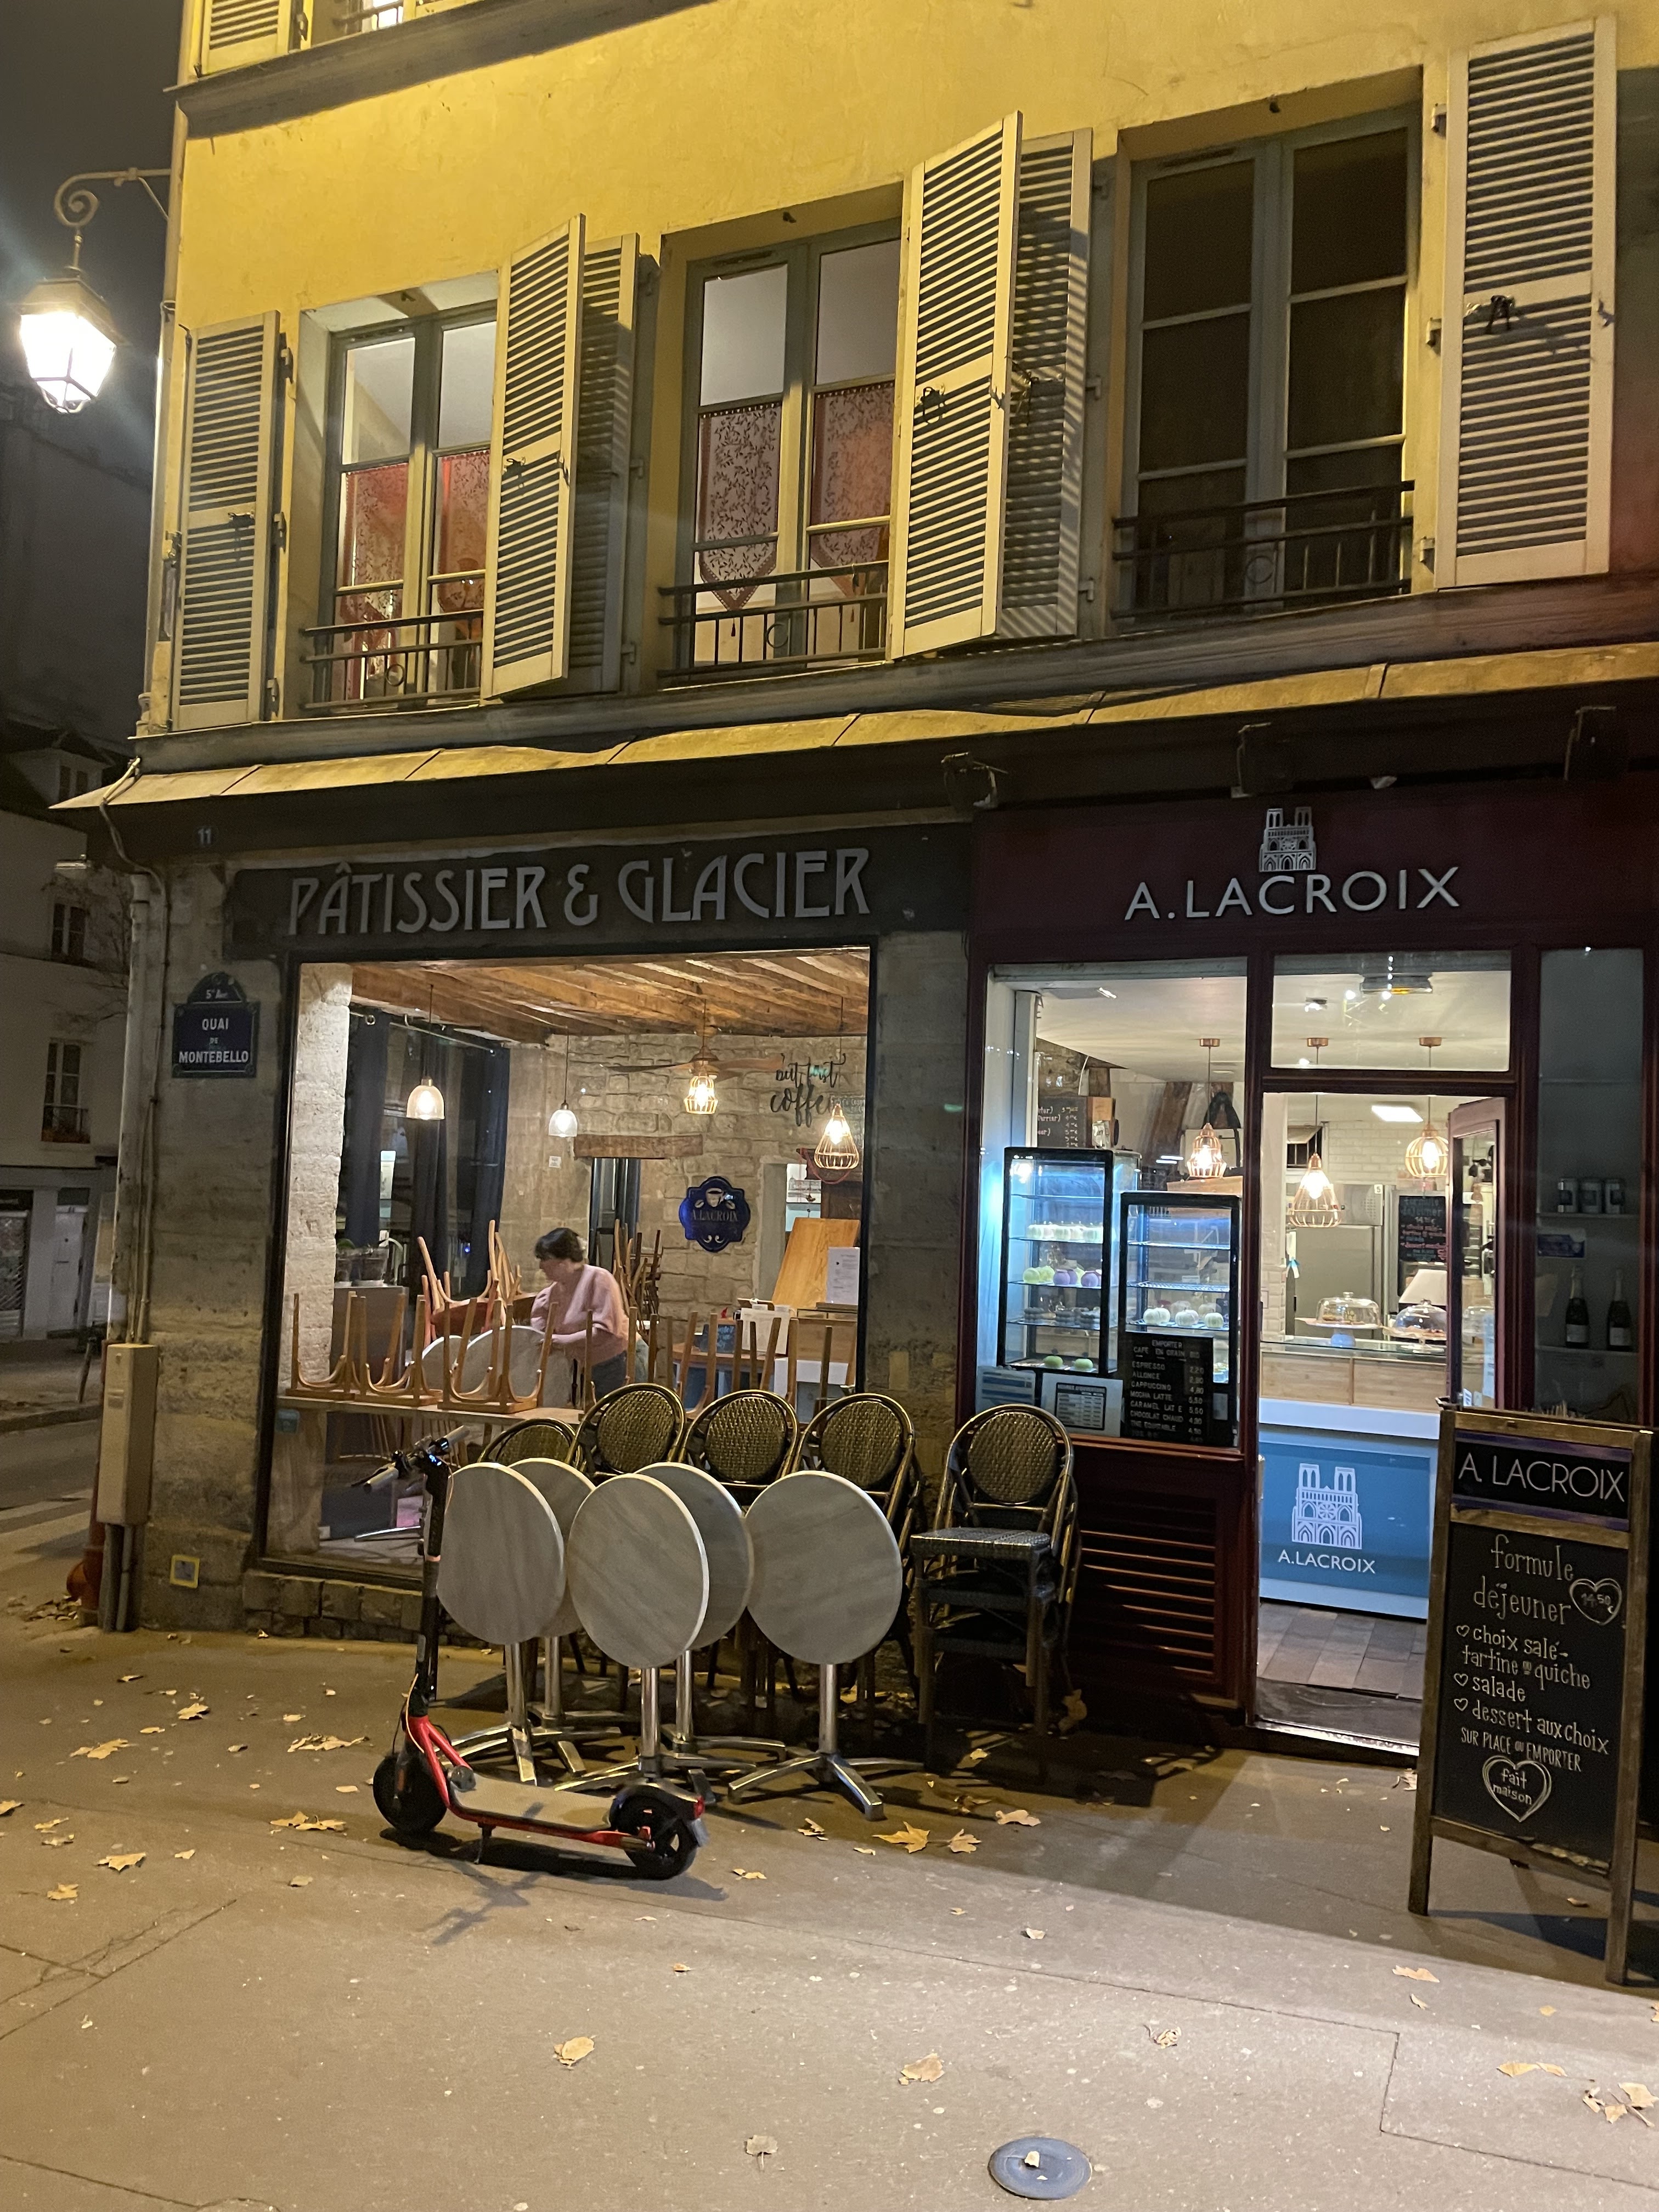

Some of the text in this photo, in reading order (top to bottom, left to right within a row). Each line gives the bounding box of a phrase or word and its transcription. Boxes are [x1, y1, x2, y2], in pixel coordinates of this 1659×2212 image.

[198, 829, 211, 843] 11
[290, 848, 871, 934] PÂTISSIER & GLACIER
[1125, 866, 1460, 921] A.LACROIX
[202, 1018, 229, 1031] QUAI
[179, 1051, 249, 1063] MONTEBELLO
[1132, 1361, 1166, 1370] ESPRESSO
[1131, 1380, 1172, 1391] CAPPUCCINO
[1153, 1393, 1173, 1402] LATTE
[1492, 1454, 1625, 1503] LACROIX
[1277, 1549, 1376, 1574] A.LACROIX
[1491, 1534, 1574, 1581] formule
[1473, 1624, 1518, 1651] choix
[1462, 1645, 1519, 1675] tartine
[1534, 1663, 1590, 1690] quiche
[1472, 1675, 1526, 1702] salade
[1472, 1700, 1532, 1733] dessert
[1460, 1726, 1479, 1745] SUR
[1482, 1731, 1512, 1755] PLACE
[1526, 1742, 1582, 1773] EMPORTER
[1501, 1768, 1528, 1790] fait
[1492, 1783, 1533, 1805] maison
